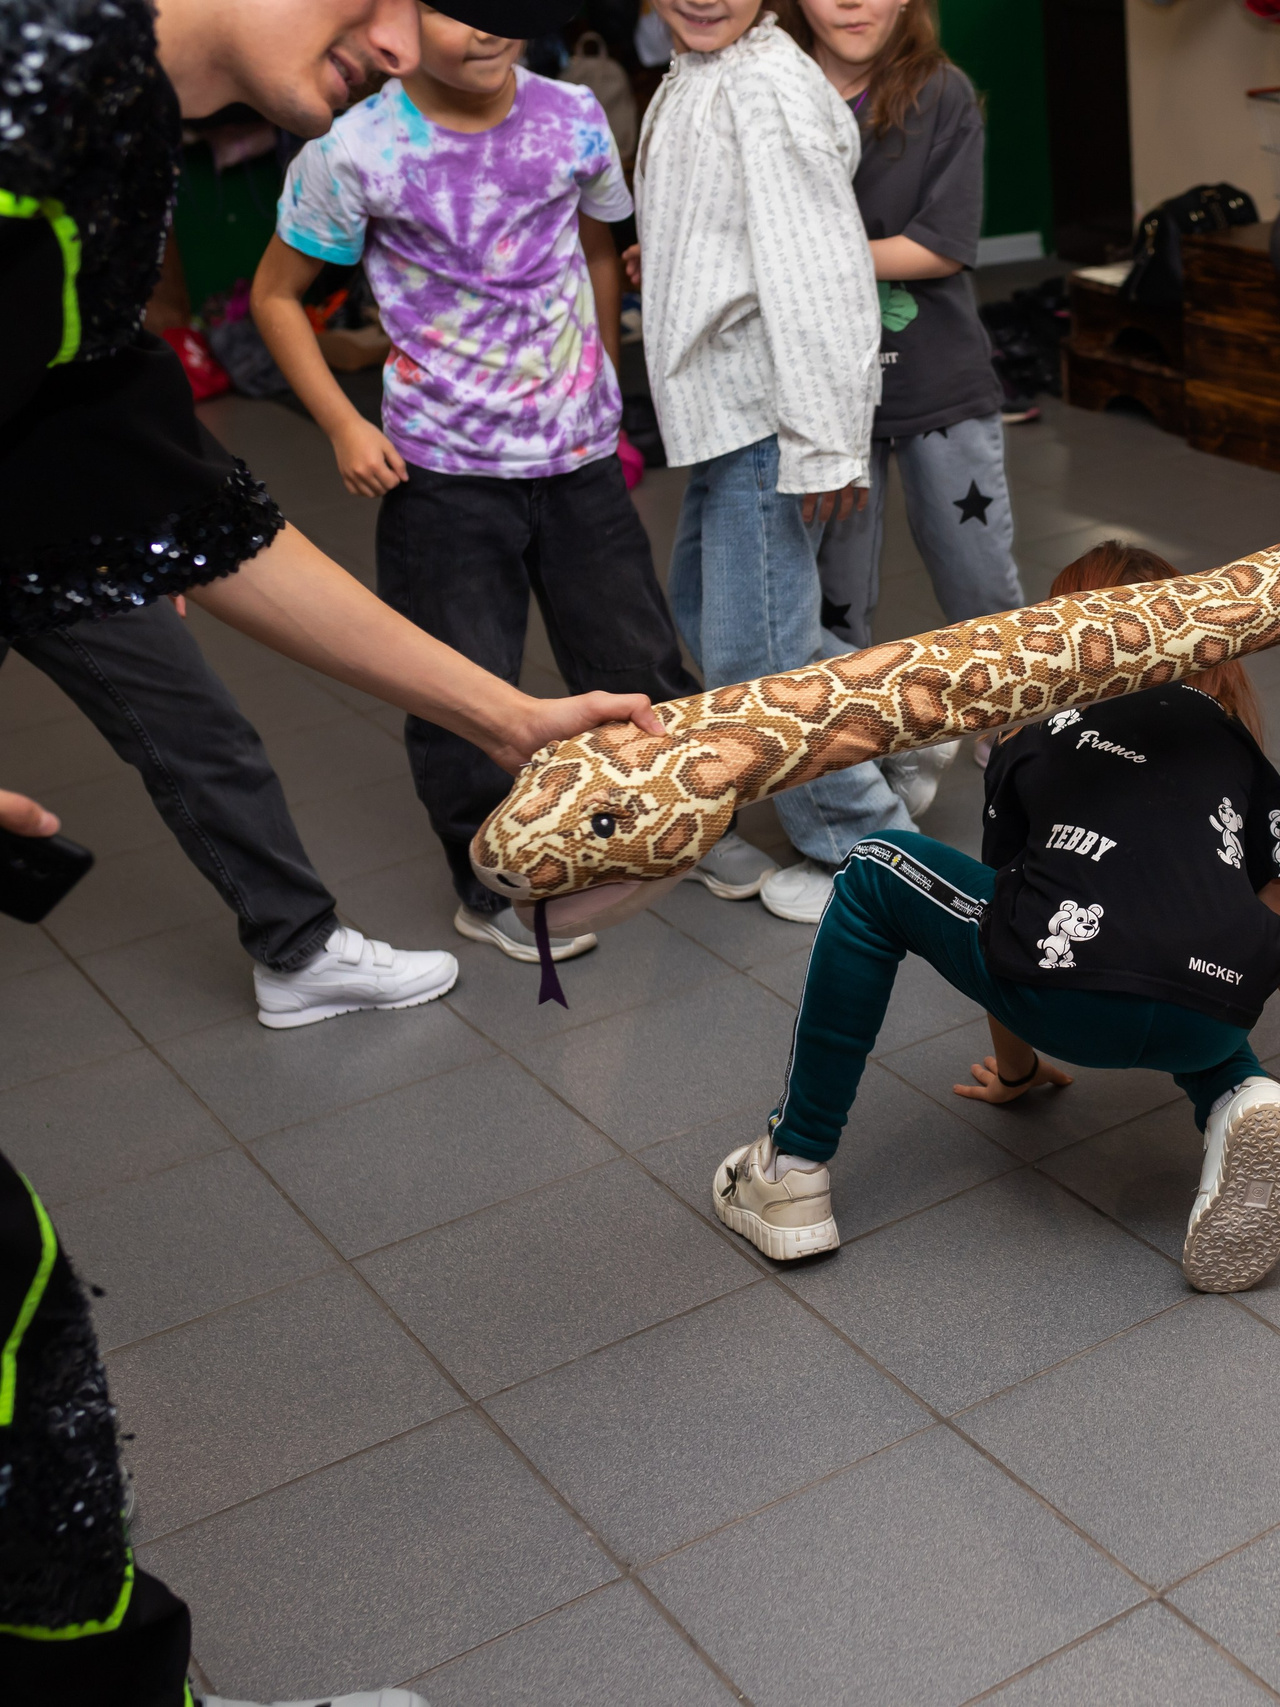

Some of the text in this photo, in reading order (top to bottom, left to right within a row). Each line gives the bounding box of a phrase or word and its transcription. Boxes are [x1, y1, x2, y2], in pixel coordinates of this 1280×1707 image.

[1076, 730, 1147, 764] France
[1045, 824, 1118, 863] TEBBY
[1188, 956, 1244, 986] MICKEY
